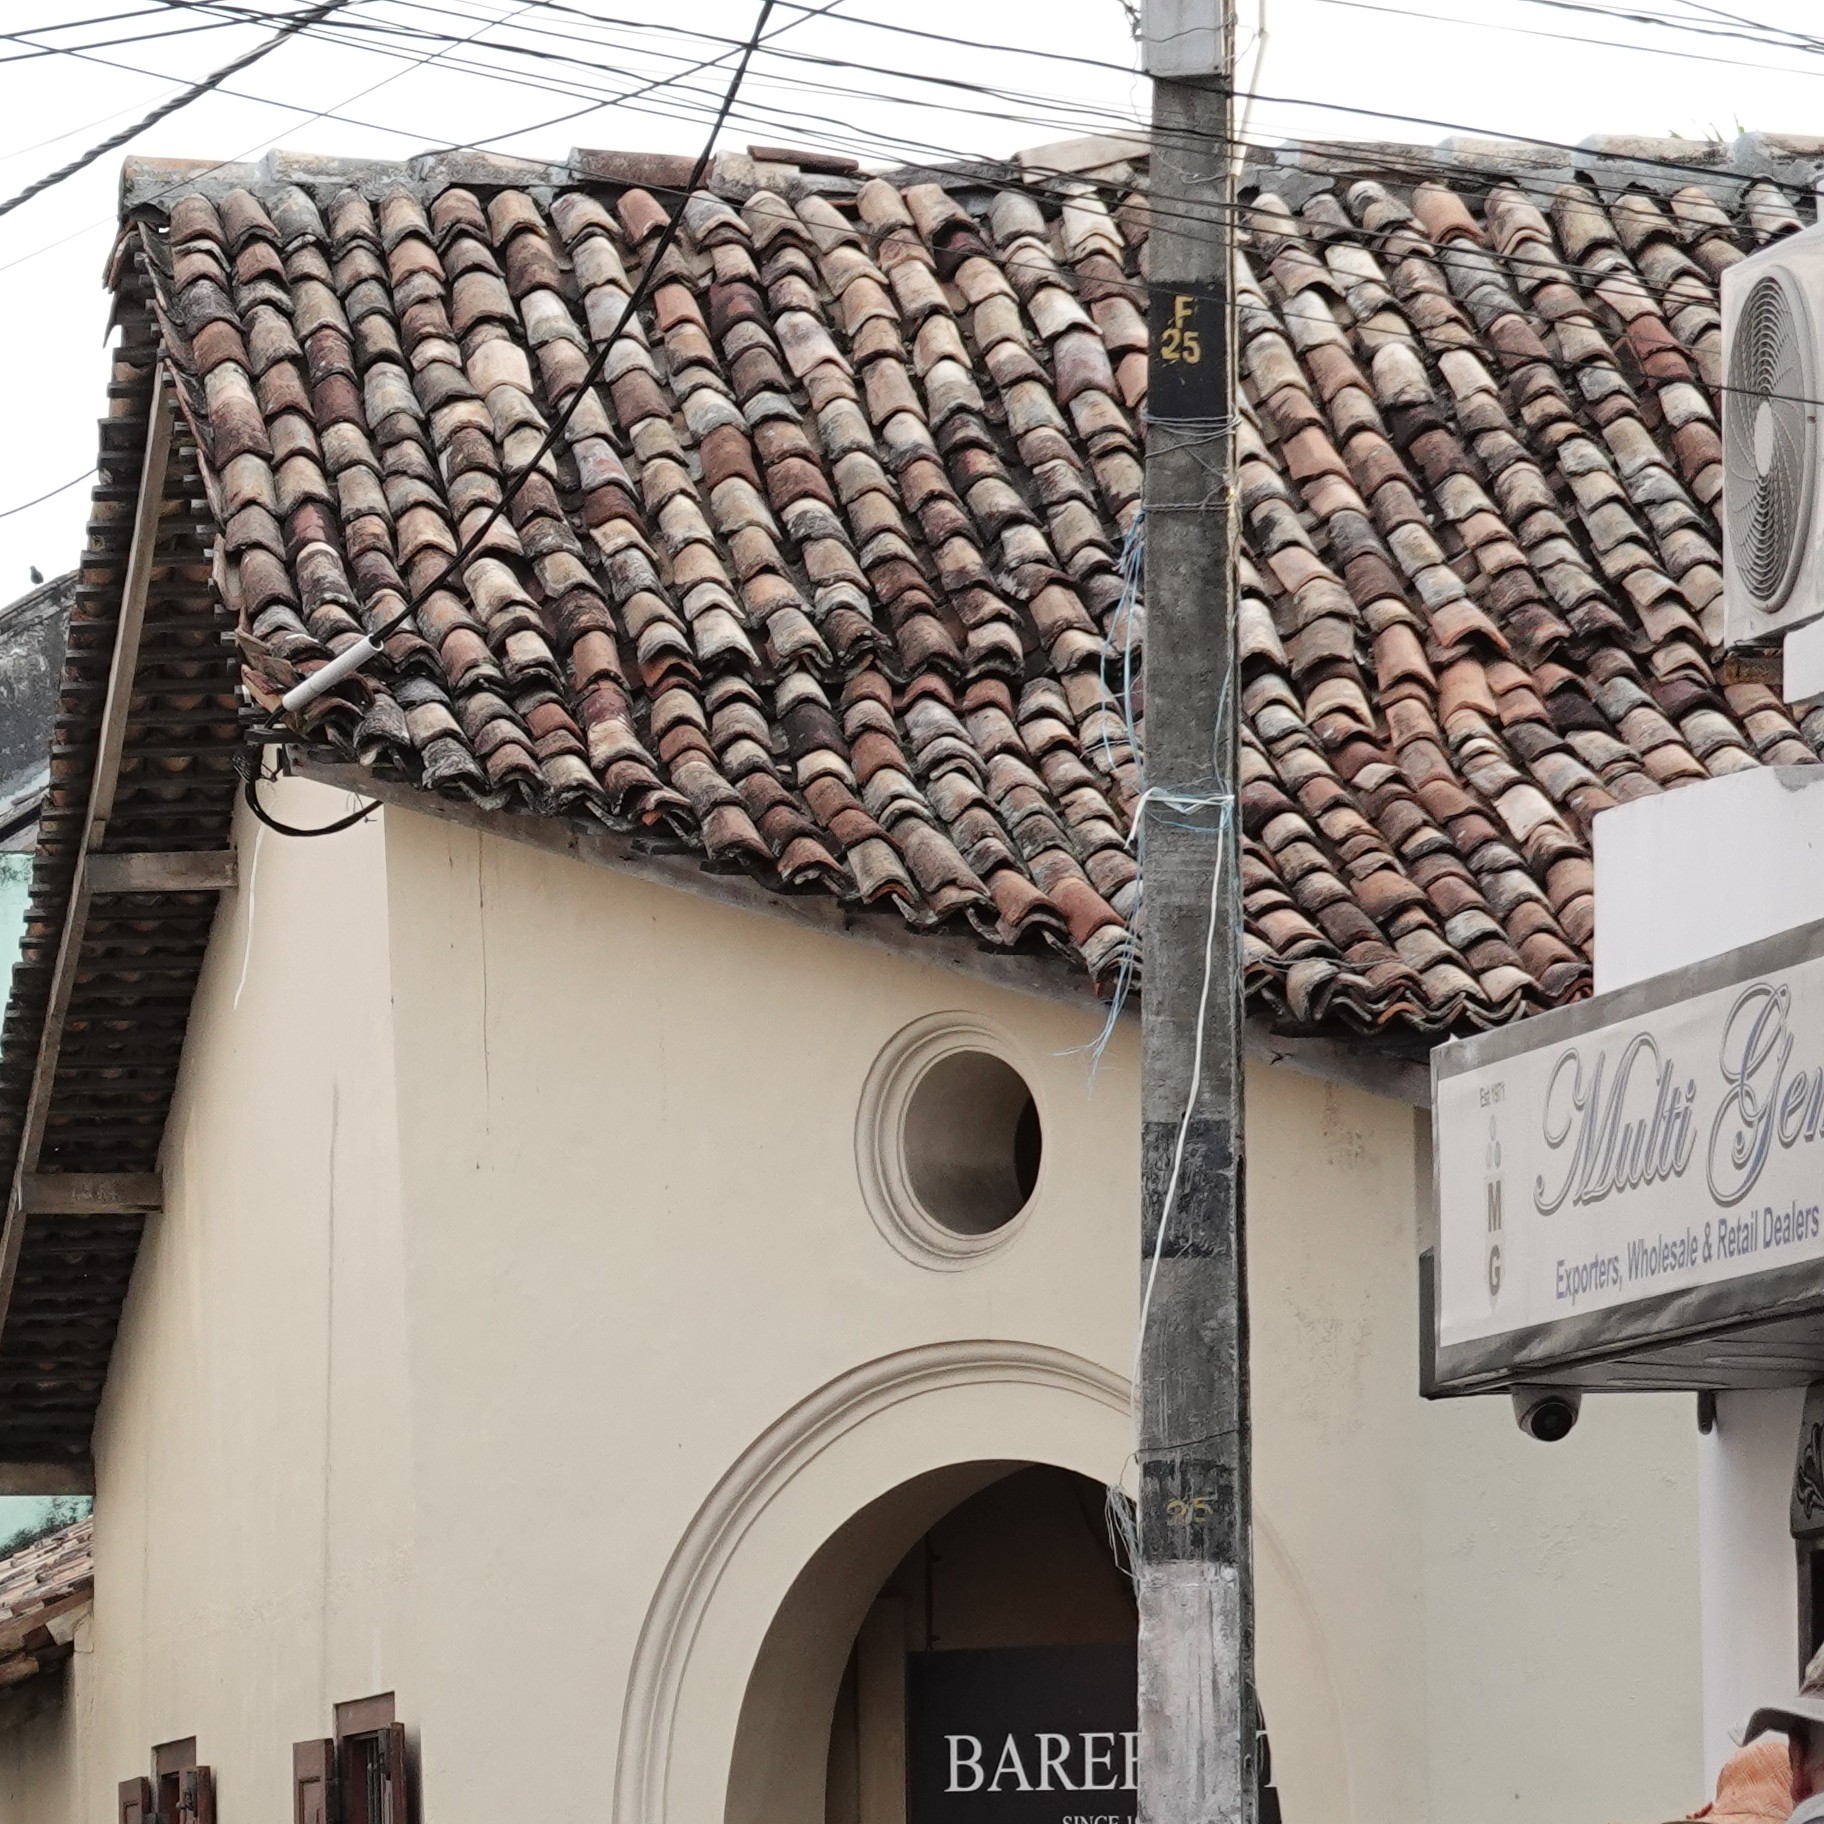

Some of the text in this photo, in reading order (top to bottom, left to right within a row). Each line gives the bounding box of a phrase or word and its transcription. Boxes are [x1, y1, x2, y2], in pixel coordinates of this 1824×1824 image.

[1160, 328, 1201, 365] 25
[1174, 294, 1196, 329] F
[1533, 1031, 1698, 1216] Multi
[1556, 1200, 1820, 1305] Exporters, Wholesale & Retail Dealers
